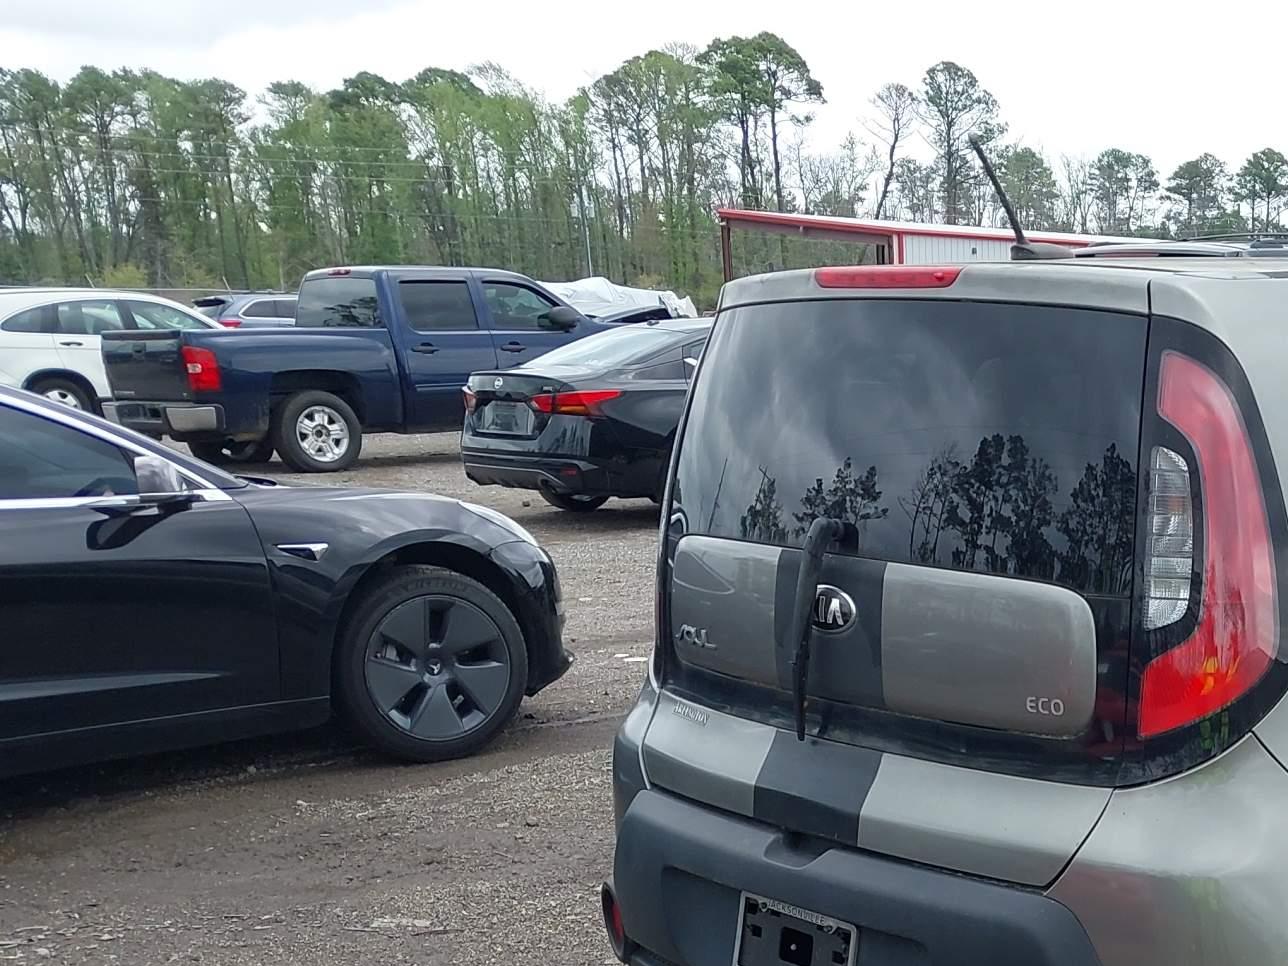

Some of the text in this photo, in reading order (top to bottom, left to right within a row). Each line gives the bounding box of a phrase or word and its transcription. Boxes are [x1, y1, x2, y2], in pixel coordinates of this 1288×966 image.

[818, 595, 844, 626] IA
[675, 623, 718, 649] SOUL
[1026, 696, 1065, 716] ECO
